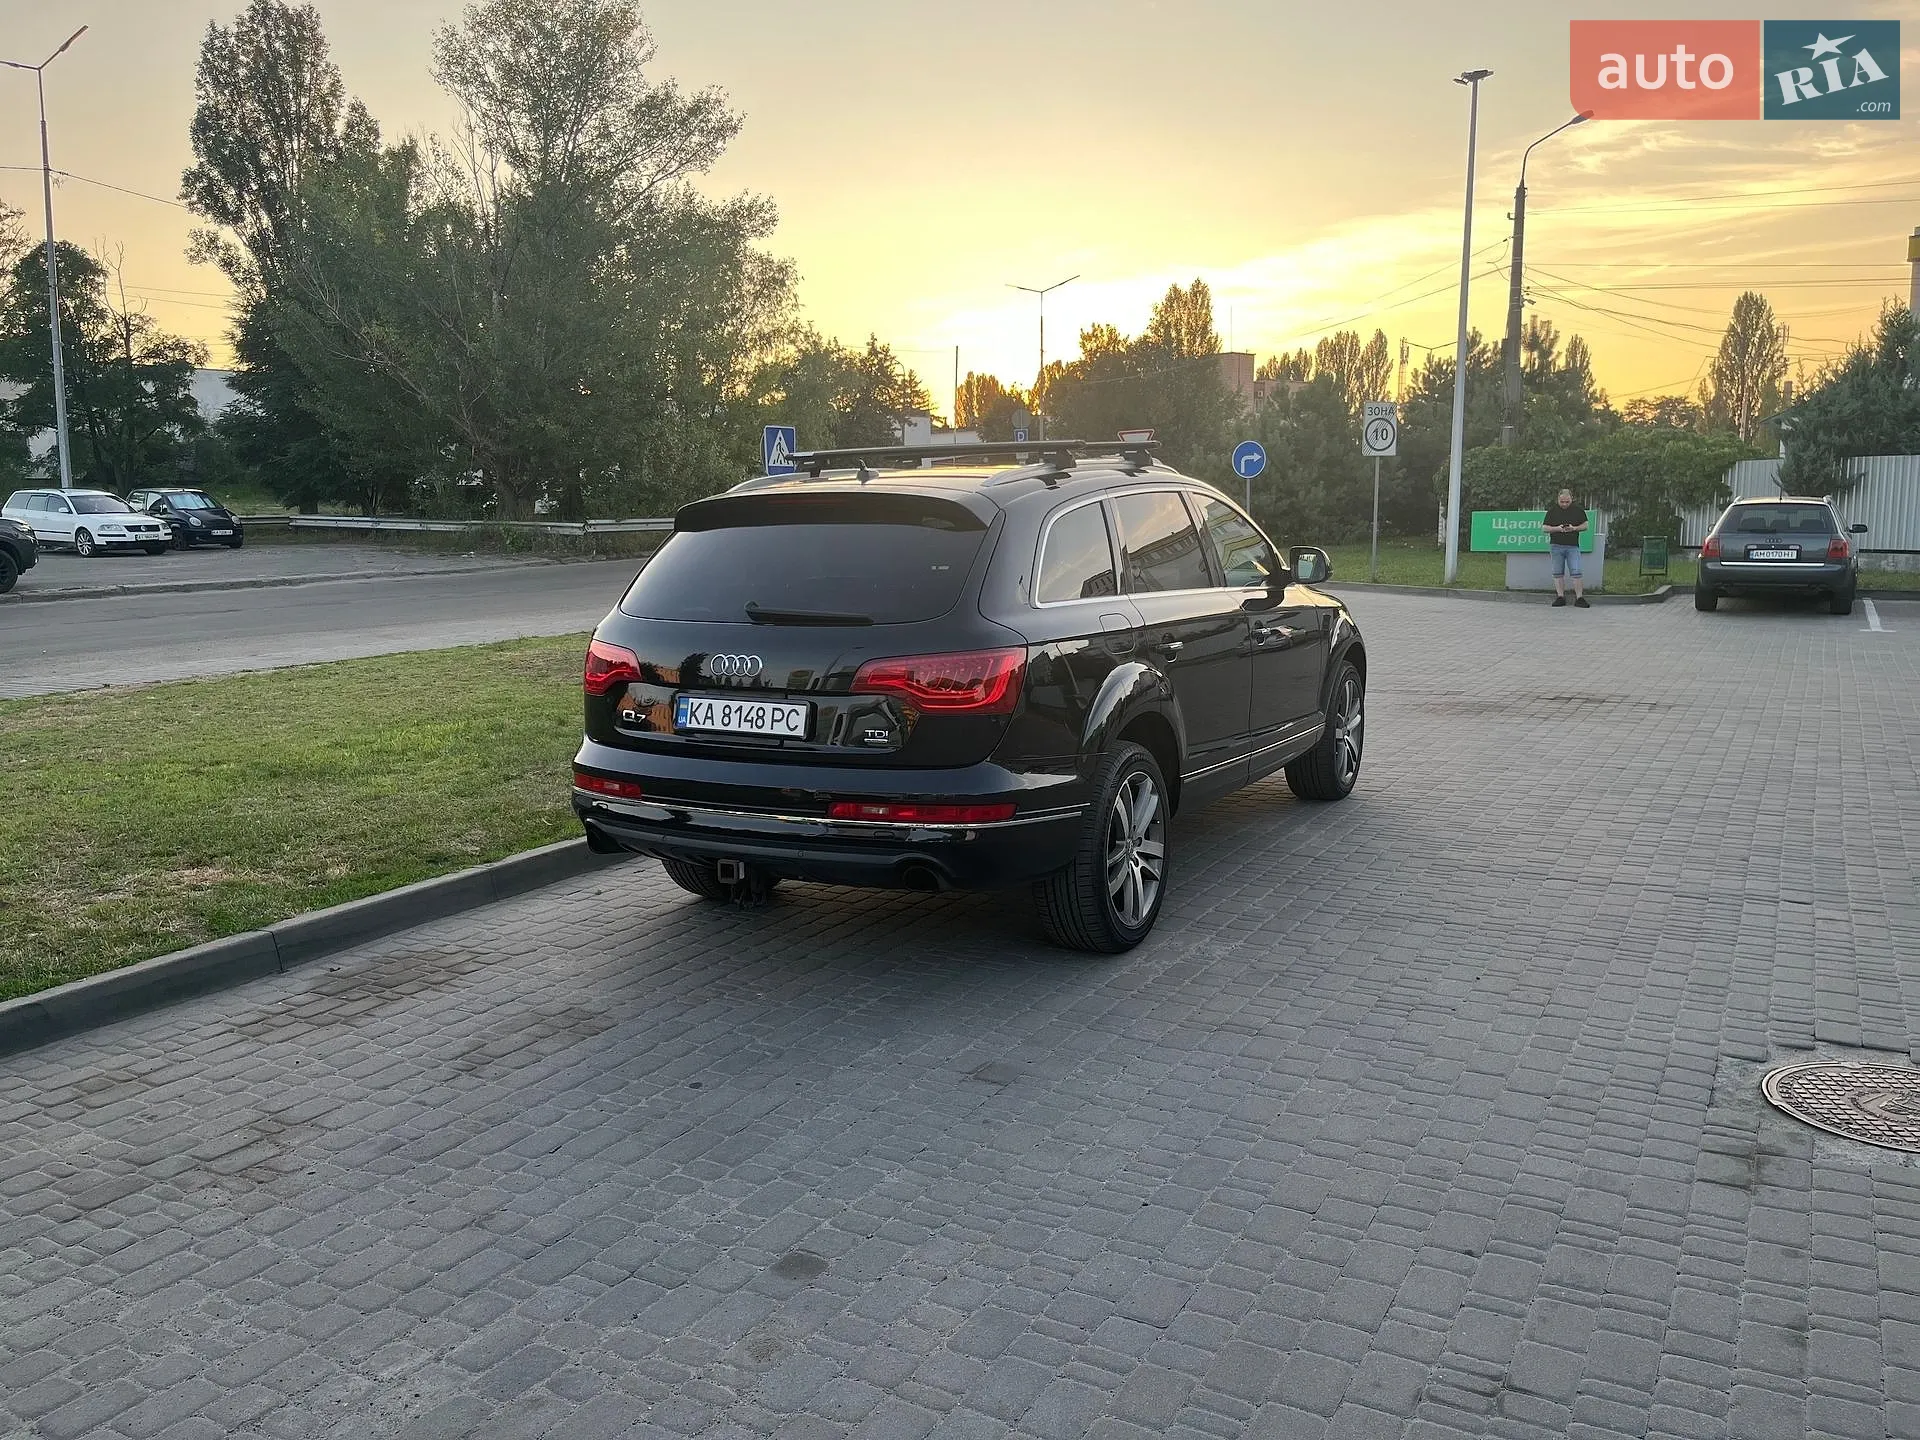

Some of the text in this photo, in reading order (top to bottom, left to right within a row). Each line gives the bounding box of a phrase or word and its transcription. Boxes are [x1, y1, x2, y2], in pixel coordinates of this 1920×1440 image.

[1367, 406, 1395, 416] ЗОНА
[1372, 428, 1389, 441] 10
[1492, 518, 1543, 530] Щасли
[622, 709, 646, 723] Q7
[689, 701, 800, 732] KA 8148 PC
[864, 729, 889, 738] TDI
